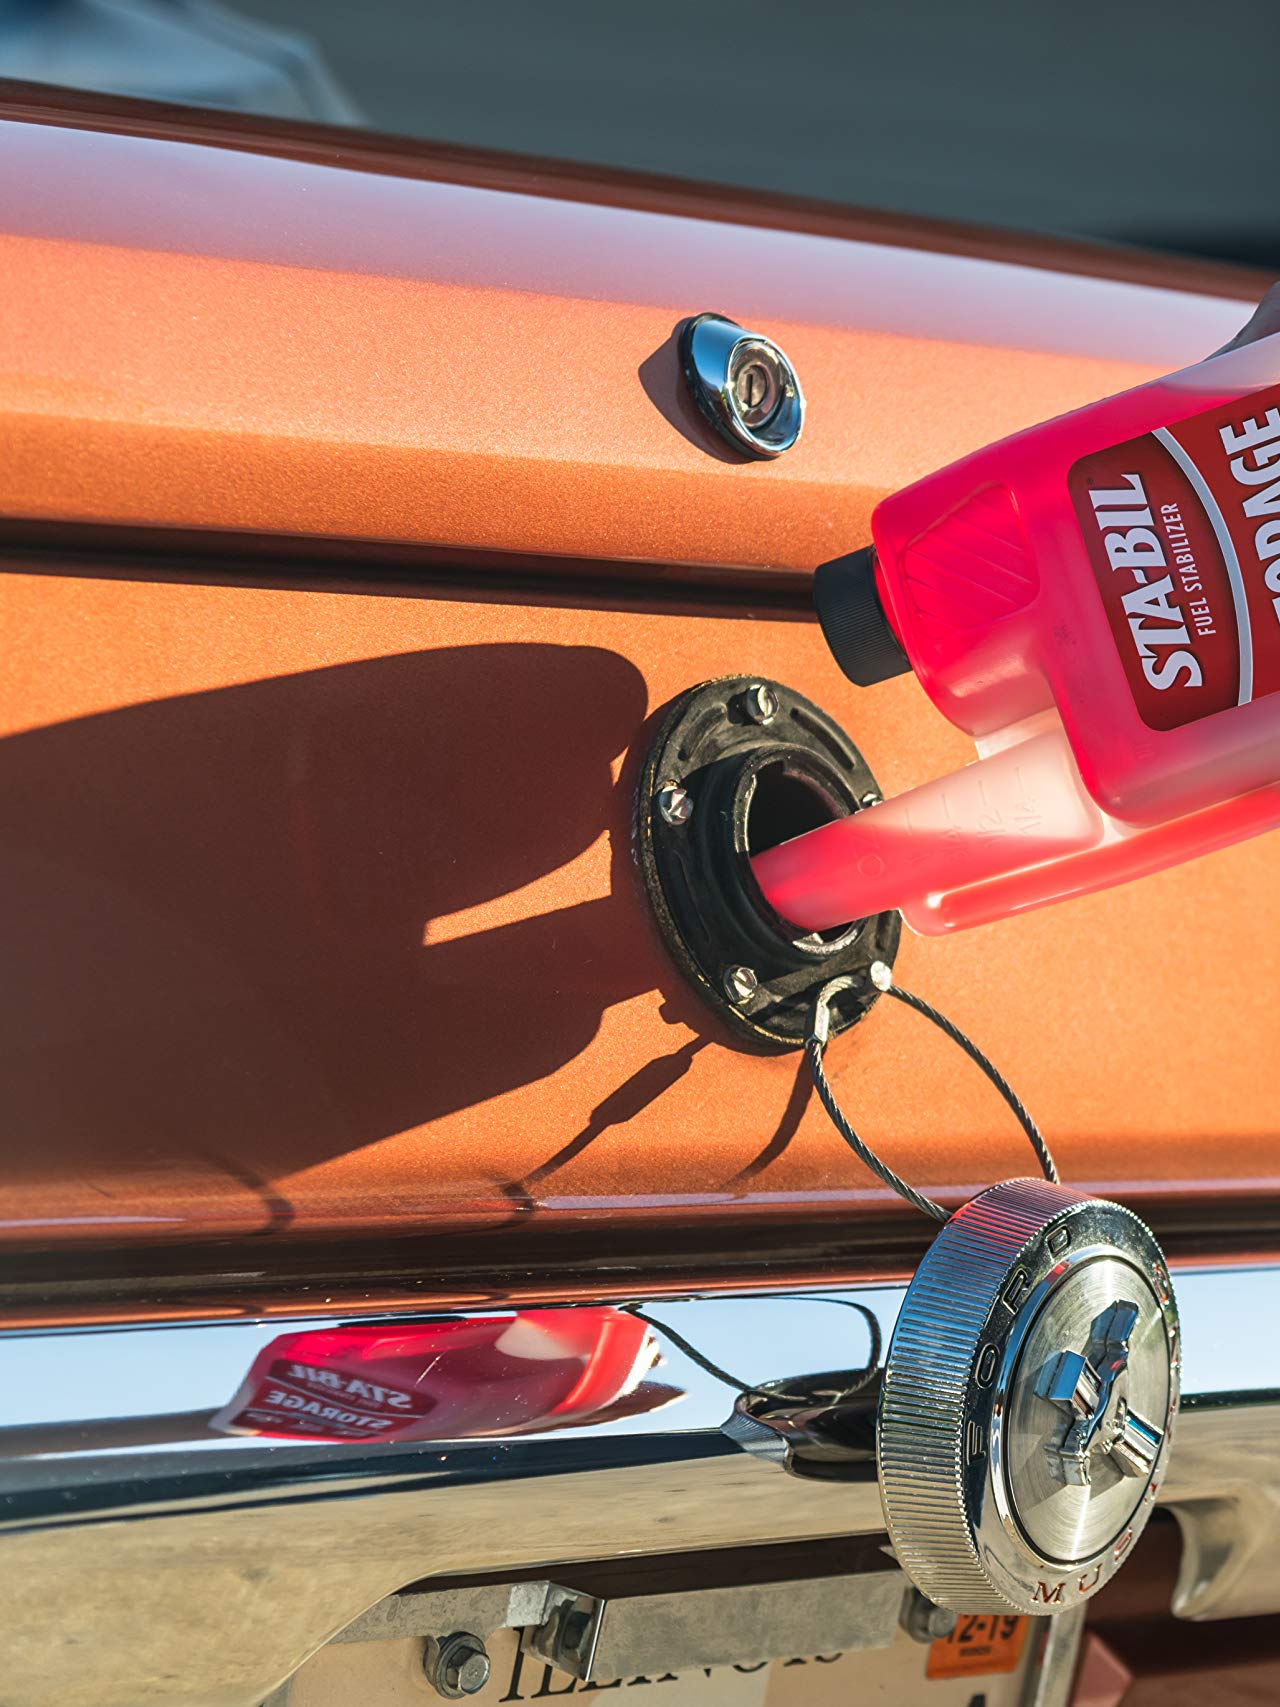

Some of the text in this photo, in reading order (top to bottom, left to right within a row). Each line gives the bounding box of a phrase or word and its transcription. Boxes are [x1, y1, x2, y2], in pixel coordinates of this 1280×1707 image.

[1088, 474, 1203, 690] STA-BIL
[1160, 502, 1217, 636] FUEL STABILIZER
[965, 1225, 1072, 1466] FORD
